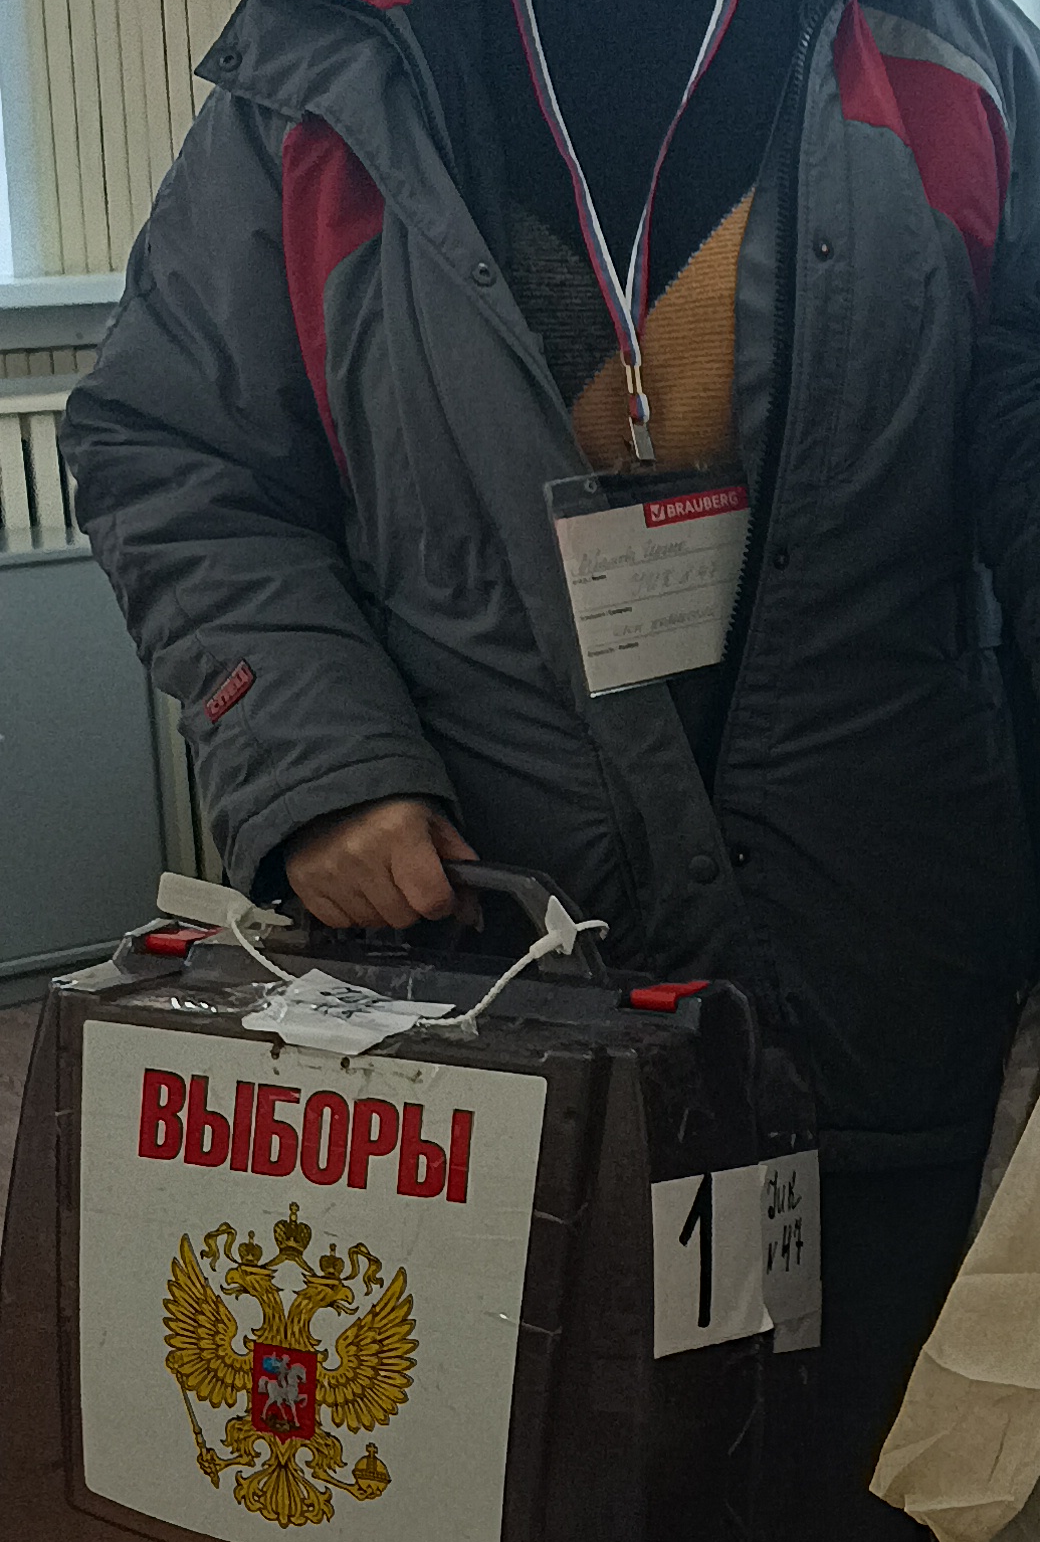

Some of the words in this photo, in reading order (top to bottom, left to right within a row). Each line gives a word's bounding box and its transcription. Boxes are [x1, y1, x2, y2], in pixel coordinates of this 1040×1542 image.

[666, 491, 739, 518] BRAUBERG
[138, 1067, 474, 1204] ВЫБОРЫ
[678, 1173, 713, 1328] 1
